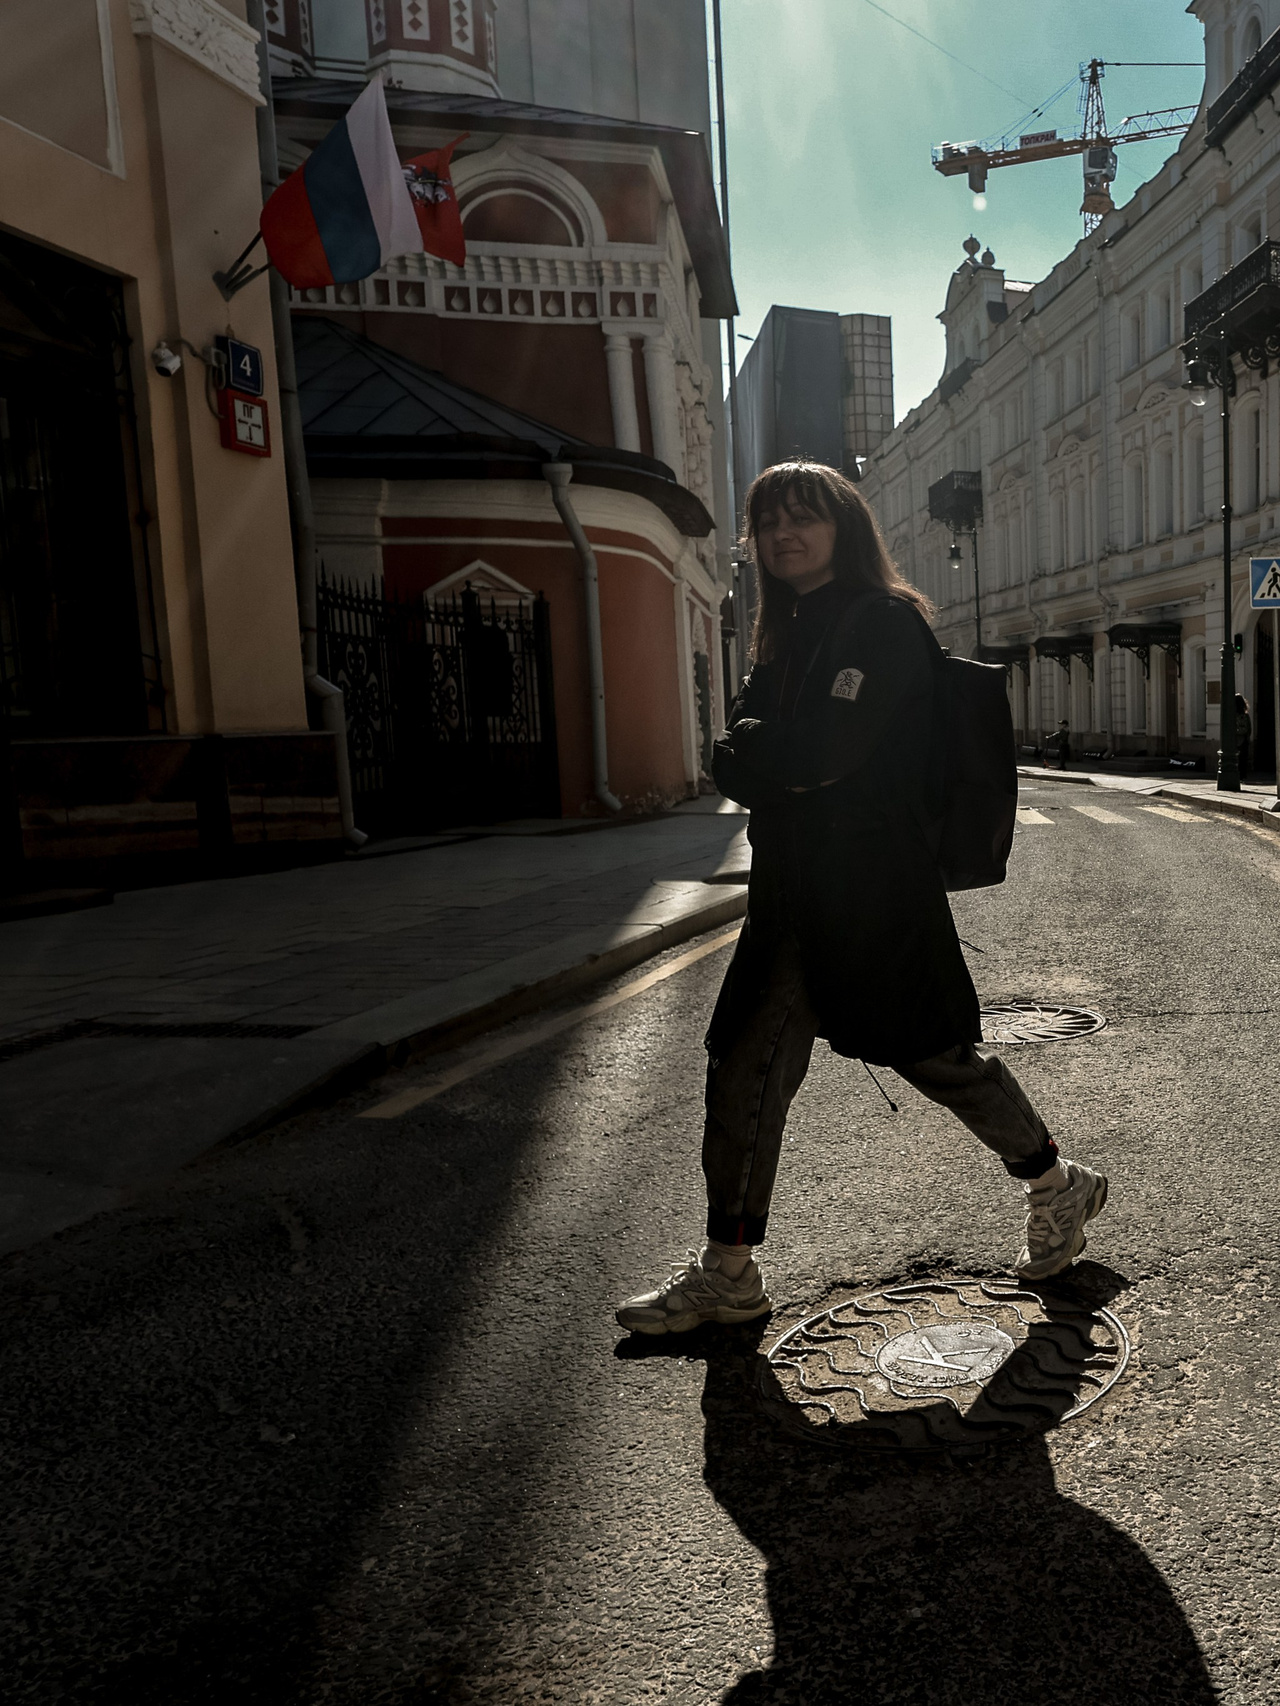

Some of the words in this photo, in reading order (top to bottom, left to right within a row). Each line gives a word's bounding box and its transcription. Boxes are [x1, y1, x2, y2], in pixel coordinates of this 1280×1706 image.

[1020, 132, 1055, 147] ТОПКРАН
[240, 354, 252, 377] 4
[243, 404, 254, 419] ПГ
[682, 1283, 721, 1307] N
